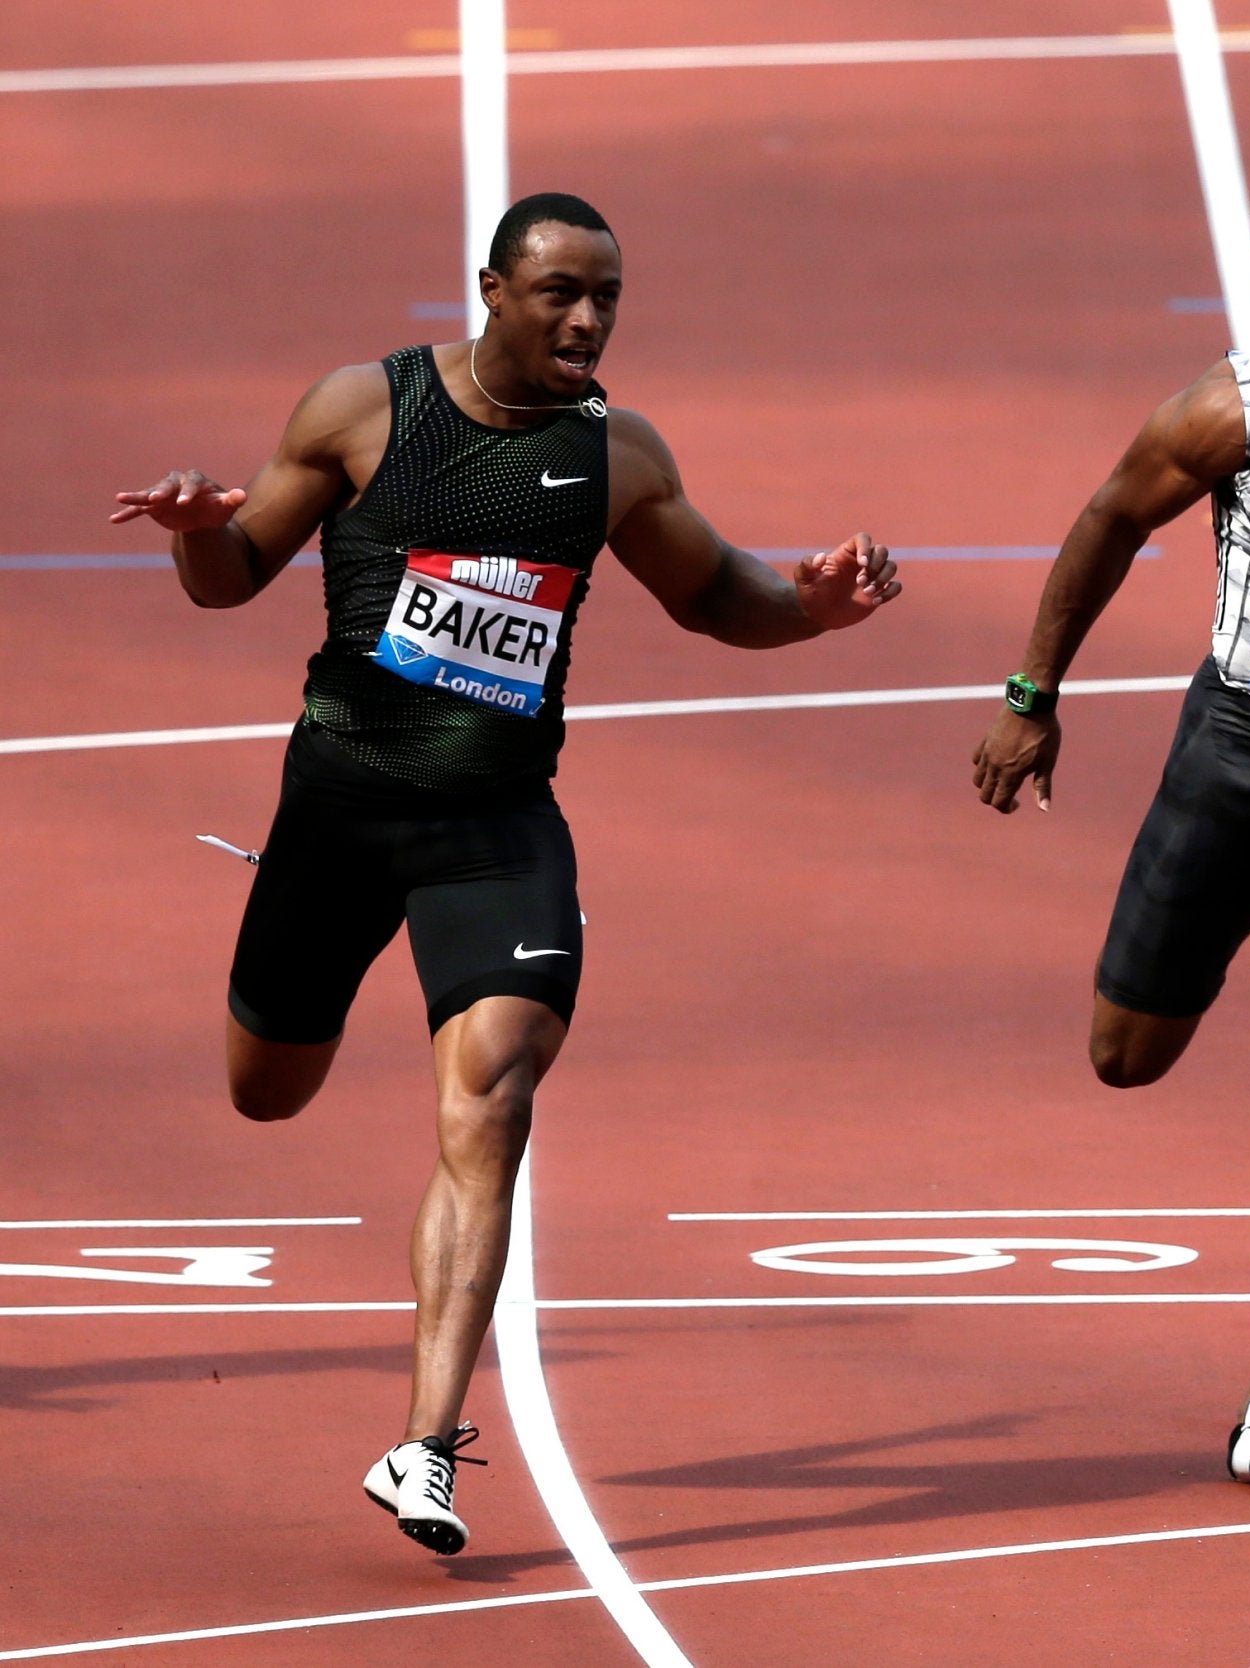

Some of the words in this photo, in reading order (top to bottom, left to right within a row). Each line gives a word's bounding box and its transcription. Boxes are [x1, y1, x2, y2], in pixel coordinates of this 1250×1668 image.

[450, 556, 544, 601] müller
[402, 583, 550, 667] BAKER
[434, 666, 527, 710] London
